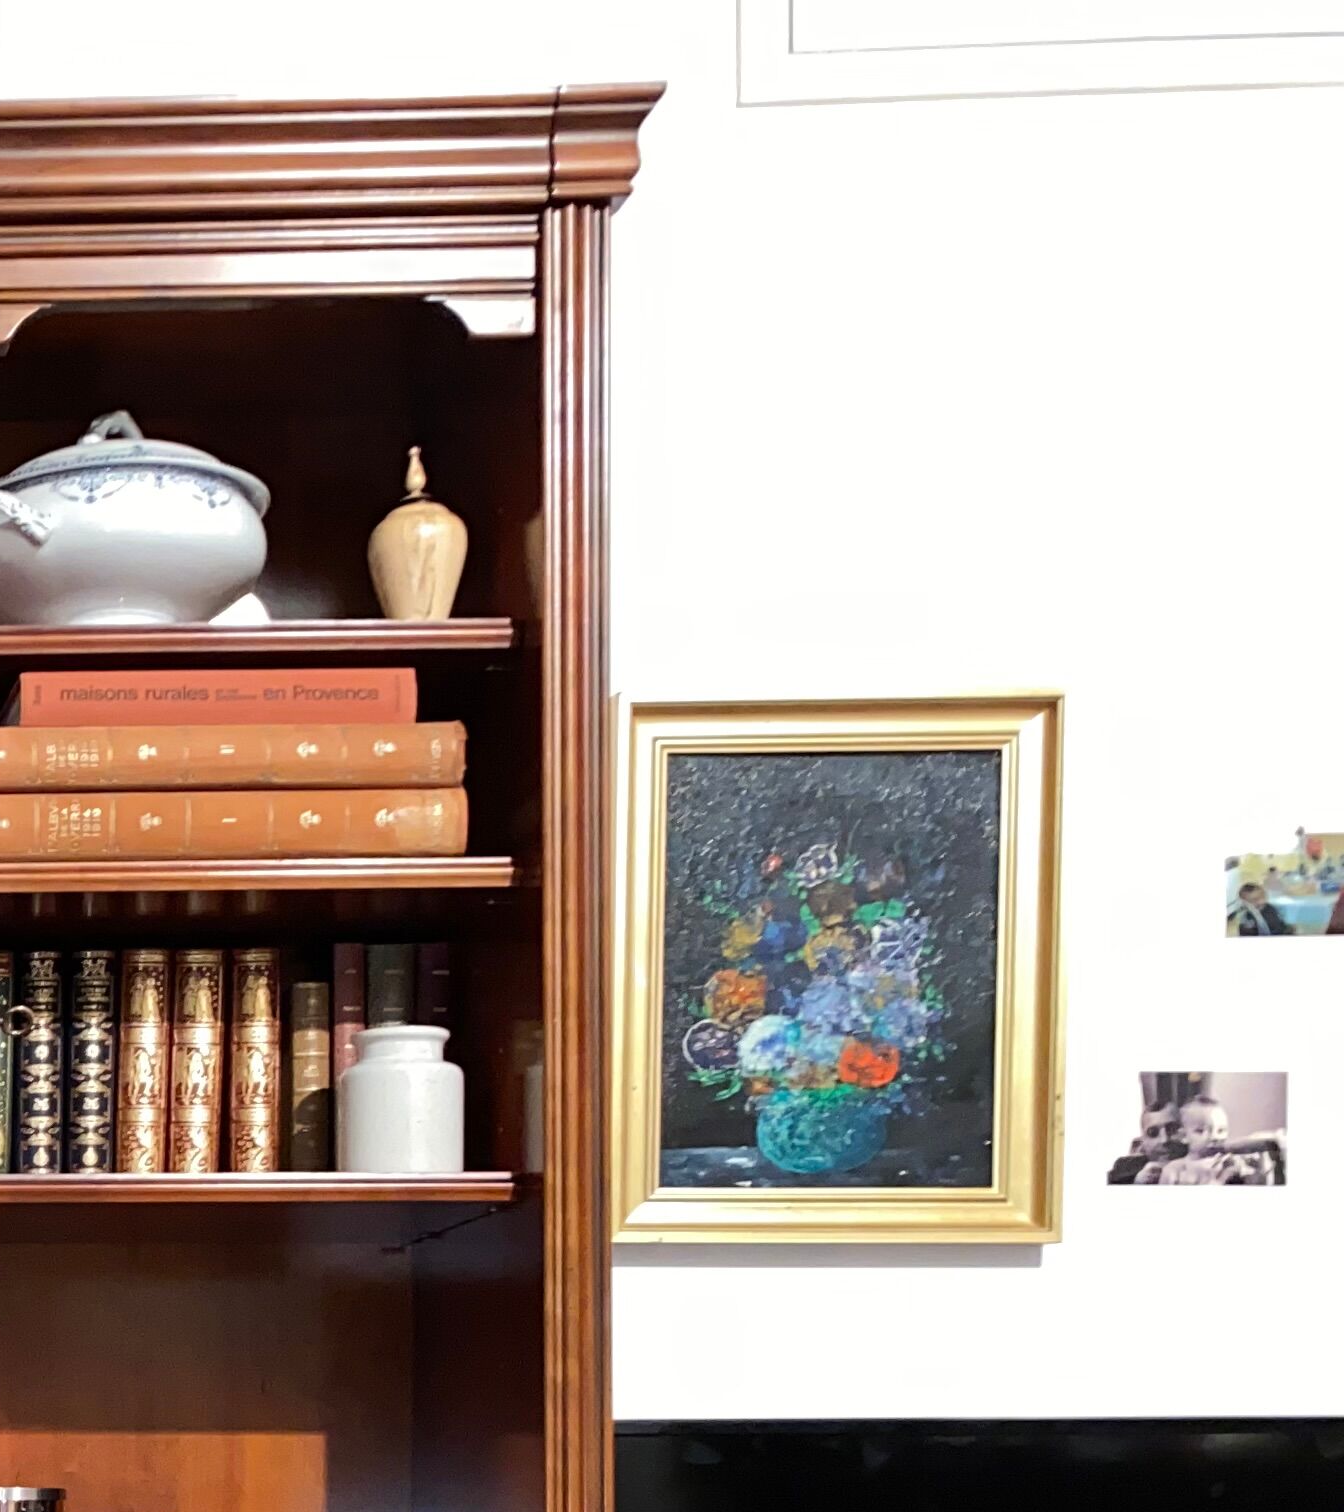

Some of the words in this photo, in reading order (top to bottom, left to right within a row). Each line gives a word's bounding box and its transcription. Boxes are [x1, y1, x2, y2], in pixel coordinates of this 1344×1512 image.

[60, 685, 138, 701] maisons
[146, 684, 209, 701] rurales
[263, 688, 286, 701] en
[293, 684, 379, 701] Provence
